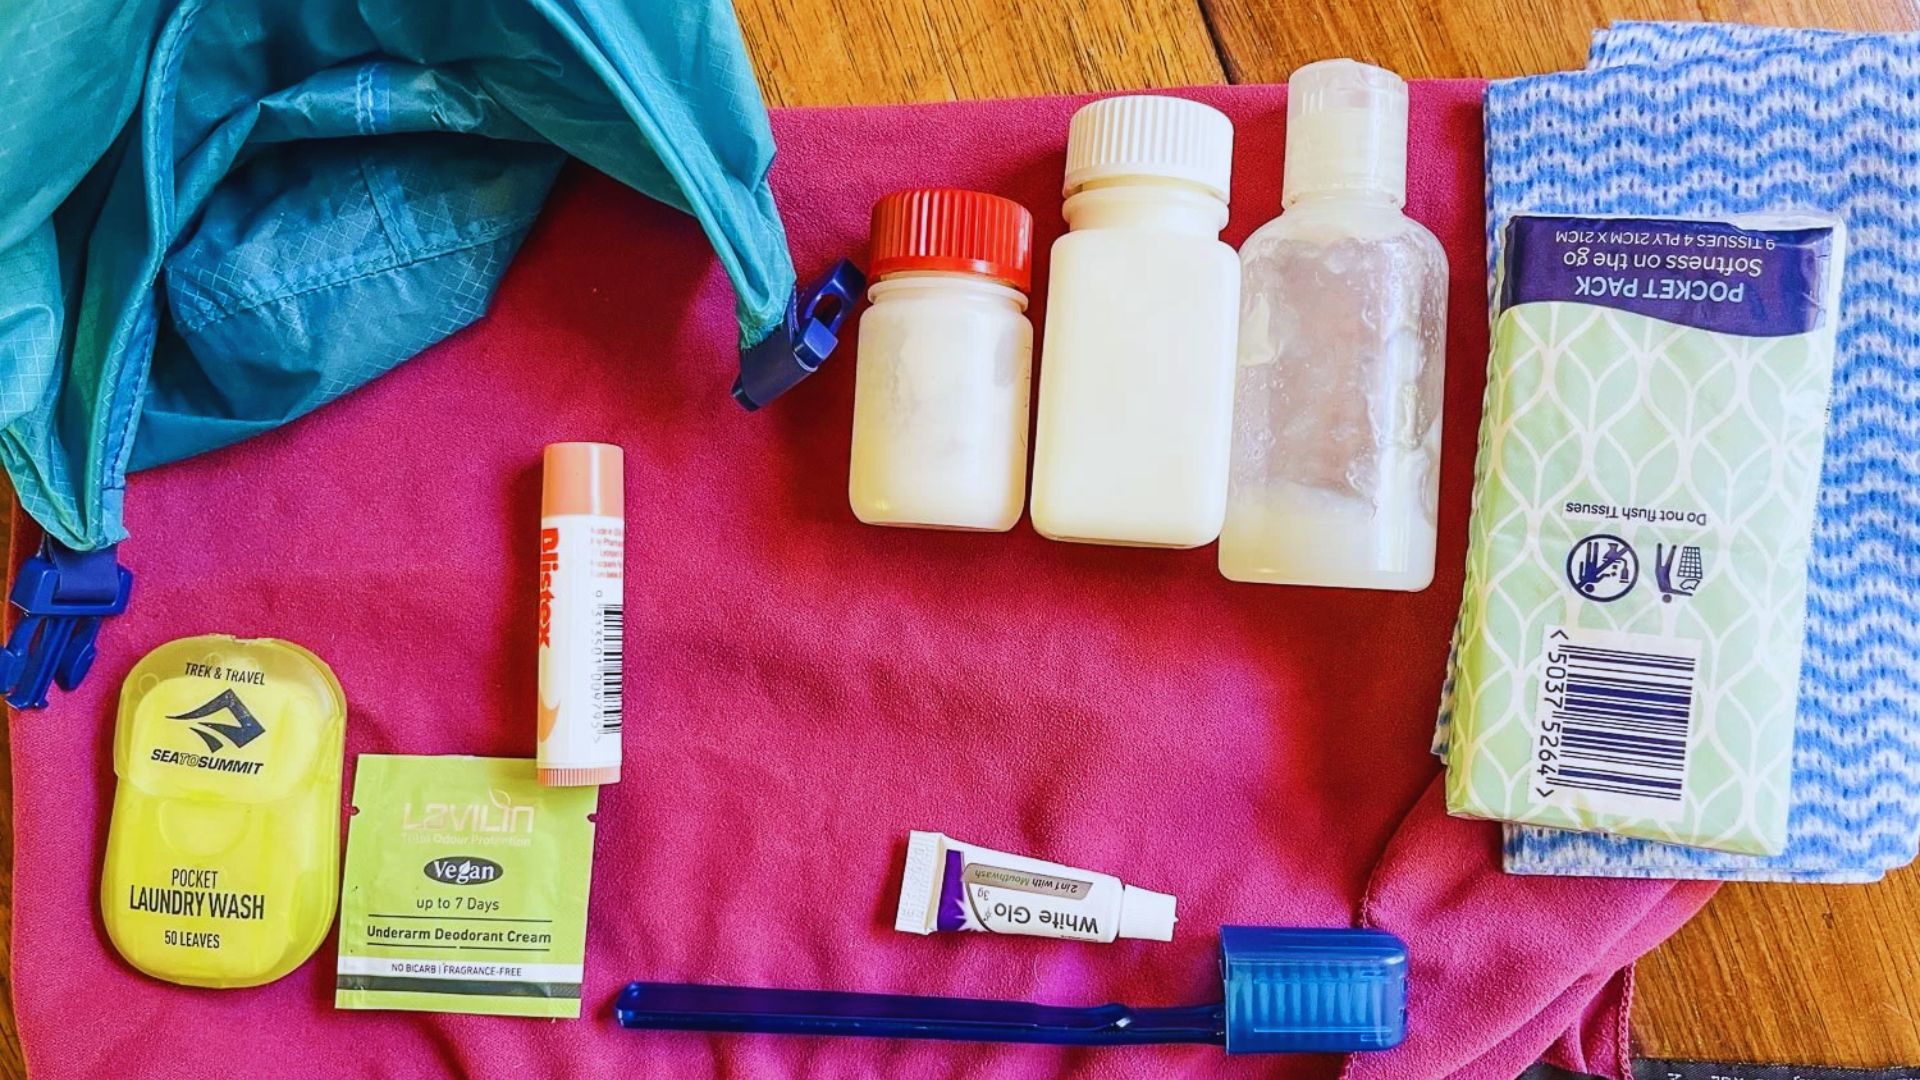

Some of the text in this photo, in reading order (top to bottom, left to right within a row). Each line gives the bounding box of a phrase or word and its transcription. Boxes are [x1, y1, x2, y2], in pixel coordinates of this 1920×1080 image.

[1556, 231, 1594, 243] 21CM
[1611, 232, 1649, 245] 21CM
[1652, 233, 1681, 246] PLY
[1684, 234, 1694, 246] 4
[1697, 235, 1762, 249] TISSUES
[1765, 239, 1775, 250] 9
[1563, 247, 1762, 277] Softness on the go
[1575, 276, 1744, 303] POCKET PACK
[1566, 502, 1706, 526] Do not flush Tissues
[185, 662, 265, 685] TREK & TRAVEL
[1537, 652, 1567, 776] 5037 5264
[172, 869, 218, 889] POCKET
[434, 860, 494, 884] Vegan
[974, 869, 1030, 886] Mouthwash
[1032, 877, 1053, 890] with
[130, 885, 265, 920] LAUNDRY WASH
[977, 887, 989, 901] 3g
[416, 897, 500, 914] up to 7 Days
[994, 901, 1099, 935] White Glo
[164, 930, 220, 949] 50 LEAVES
[367, 925, 551, 943] Underarm Deodorant Cream
[391, 963, 522, 977] NO BICARB FRAGRANCE-FREE
